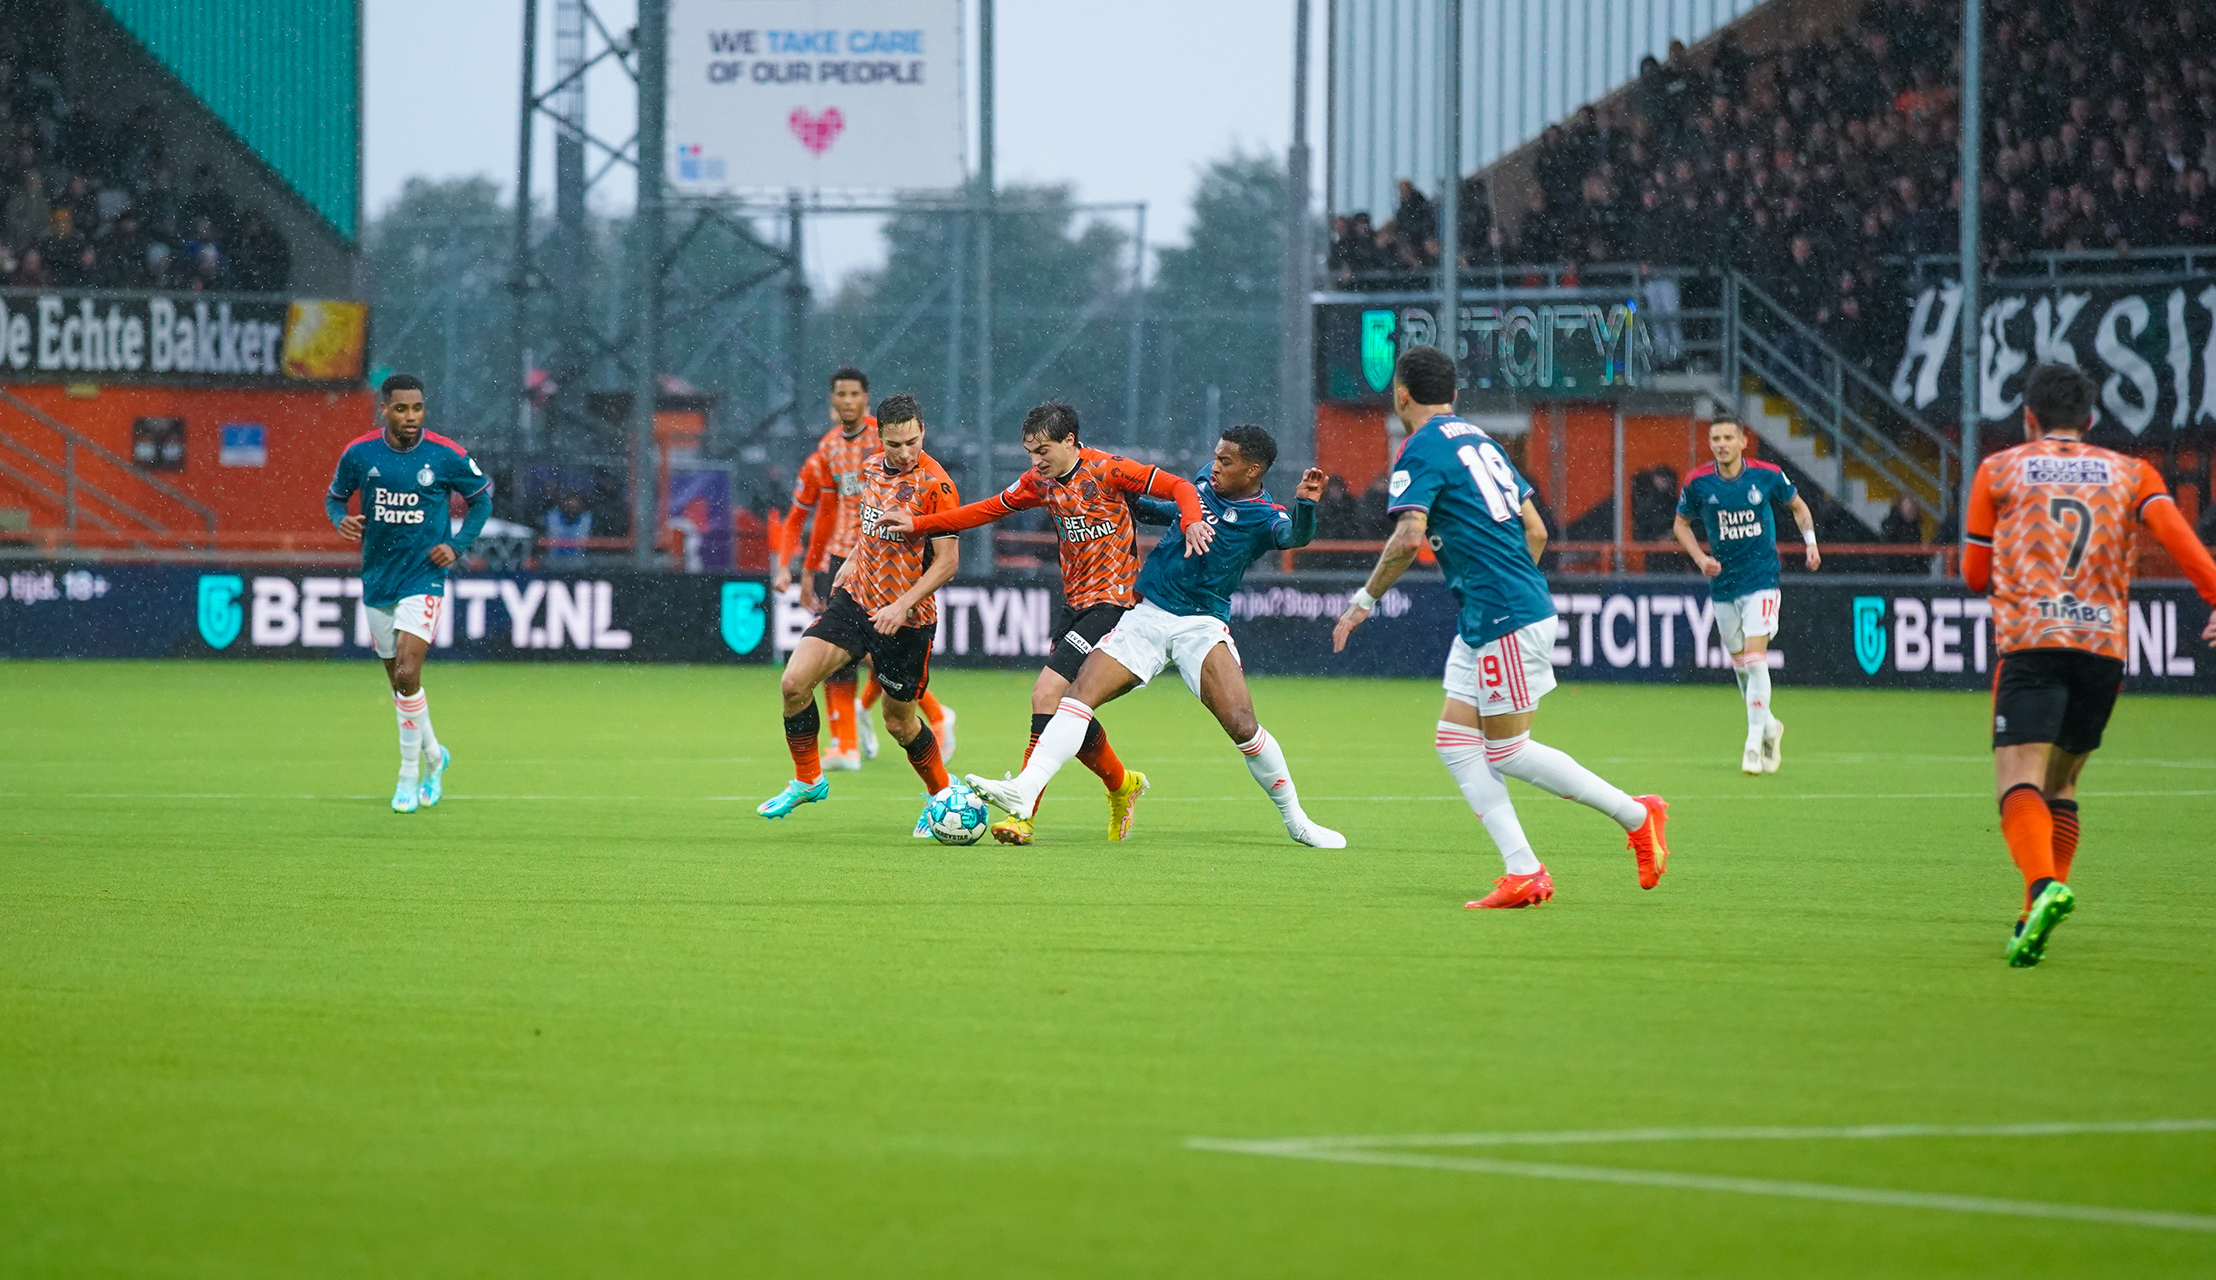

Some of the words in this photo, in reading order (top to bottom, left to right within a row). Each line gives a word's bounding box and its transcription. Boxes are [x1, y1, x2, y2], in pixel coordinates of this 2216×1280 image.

[709, 30, 757, 54] WE
[767, 30, 839, 53] TAKE
[847, 30, 923, 53] CARE
[708, 61, 744, 84] OF
[752, 61, 811, 84] OUR
[818, 61, 923, 84] PEOPLE
[38, 297, 145, 371] Echte
[150, 299, 281, 375] Bakker
[1892, 277, 2216, 436] HEKSI
[2028, 459, 2106, 472] KEUKEN
[1457, 442, 1523, 523] 19
[375, 487, 419, 506] Euro
[374, 504, 425, 524] Parcs
[1063, 515, 1086, 530] BET
[1717, 509, 1756, 527] Euro
[1067, 521, 1117, 543] CITY.NL
[1719, 522, 1762, 541] Parcs
[2050, 498, 2092, 580] 7
[424, 594, 435, 619] 9
[1762, 598, 1773, 618] 17
[2038, 599, 2113, 625] TIMBO
[1477, 655, 1504, 690] 19
[934, 827, 969, 840] DERBYSTAR
